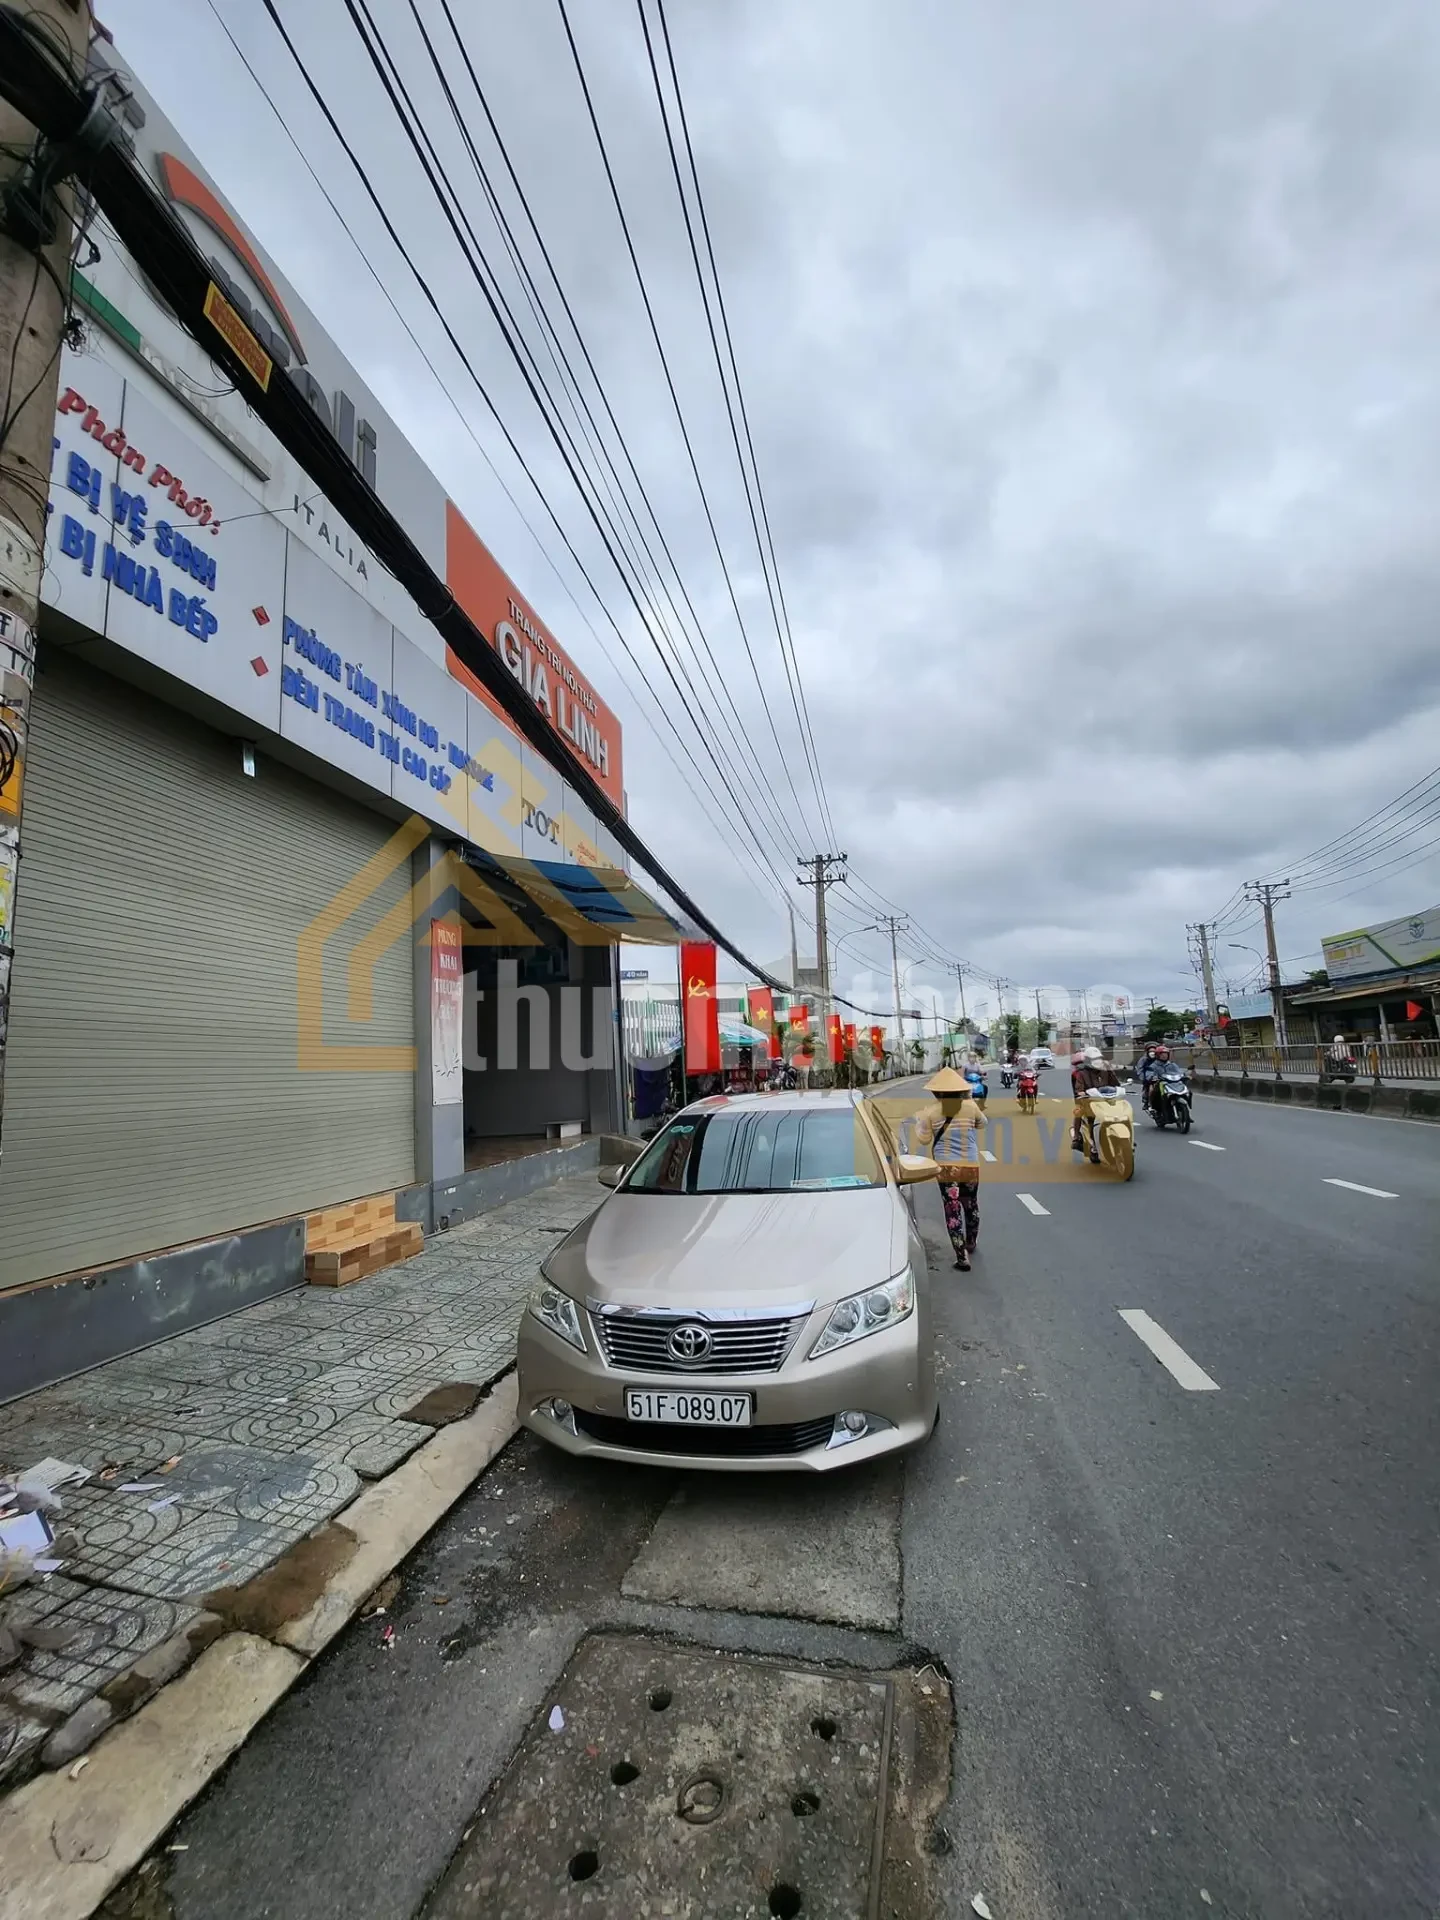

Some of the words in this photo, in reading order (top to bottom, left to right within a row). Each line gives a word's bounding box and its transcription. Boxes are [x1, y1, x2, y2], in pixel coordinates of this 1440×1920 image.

[67, 451, 102, 515] BỊ
[111, 483, 148, 545] VỆ
[154, 519, 217, 591] SINH
[294, 494, 368, 581] ITALIA
[60, 514, 96, 577] BỊ
[102, 541, 164, 614] NHÀ
[169, 587, 218, 643] BẾP
[283, 614, 341, 682] PHÒNG
[507, 596, 546, 655] TRANG
[323, 692, 375, 750] TRANG
[402, 747, 427, 781] CAO
[495, 620, 552, 719] GIA
[556, 686, 609, 778] LINH
[630, 1394, 746, 1423] 51F-089.07
